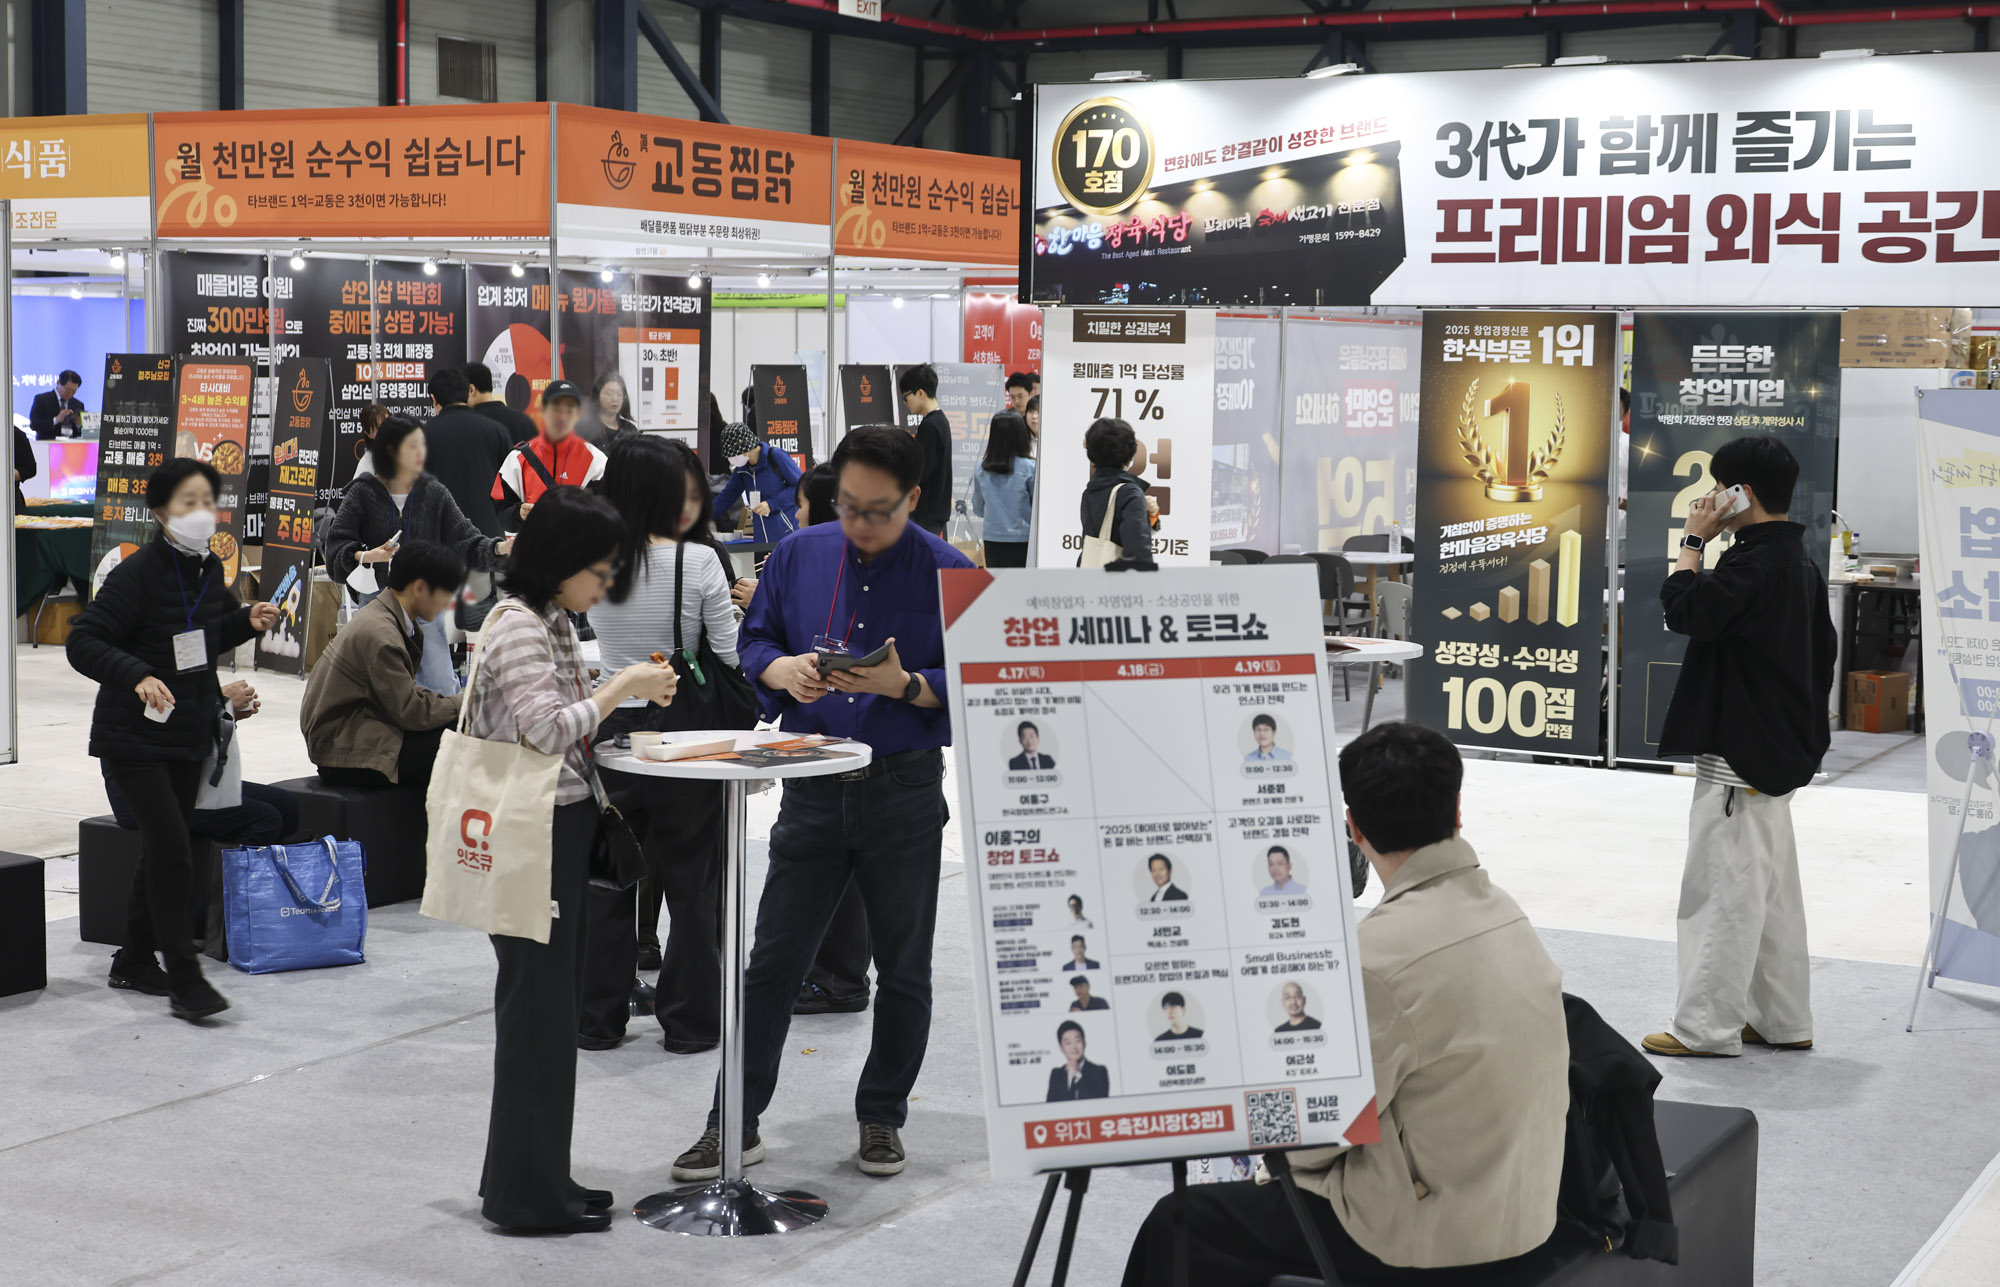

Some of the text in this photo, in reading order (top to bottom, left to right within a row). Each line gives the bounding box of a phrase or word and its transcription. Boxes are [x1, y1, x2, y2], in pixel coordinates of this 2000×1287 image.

[857, 0, 877, 16] EXIT
[1071, 127, 1141, 169] 170
[1163, 116, 1389, 172] 변화에도 한결같이 성장한 브랜드
[1599, 113, 1719, 176] 함께
[1732, 109, 1917, 174] 즐기는
[5, 138, 67, 179] 식품
[177, 135, 525, 180] 월 천만원 순수익 쉽습니다
[651, 136, 795, 205] 교동찜닭
[1083, 170, 1124, 194] 호점
[248, 192, 447, 208] 타브랜드 1억=교동은 3천이면 가능합니다!
[849, 169, 974, 214] 월 천만원 순수익
[1203, 198, 1381, 233] 프리미엄 전문점
[641, 219, 760, 241] 배달플랫폼 찜닭부분 주문량 최상위권!
[892, 221, 916, 235] 타브랜드
[1299, 228, 1382, 243] 가맹문의 1599-8429
[1431, 190, 2000, 265] 프리미엄 외식 공간
[1112, 251, 1124, 259] Best
[1125, 250, 1140, 260] Aged
[1157, 245, 1192, 256] Restaurant
[197, 273, 258, 298] 매몰비용
[397, 281, 442, 306] 박람회
[478, 286, 500, 307] 업계
[503, 286, 528, 307] 최저
[662, 295, 702, 314] 전격공개
[384, 310, 415, 334] 상담
[419, 311, 454, 336] 가능!
[1086, 320, 1171, 336] 치밀한 상권분석
[1445, 325, 1529, 337] 2025 창업경영신문
[973, 324, 995, 342] 고객이
[384, 343, 434, 360] 전체 매장중
[1443, 339, 1532, 363] 한식부문
[1538, 324, 1595, 367] 1위
[157, 359, 171, 369] 신규
[659, 348, 678, 362] 초반!
[1691, 344, 1775, 374] 든든한
[385, 362, 425, 379] 미만으로
[1073, 363, 1185, 380] 월매출 1억 달성률
[200, 382, 231, 393] 타사대비
[1679, 378, 1785, 407] 창업지원
[1657, 414, 1683, 425] 박람회
[1683, 414, 1716, 426] 기간동안
[1733, 415, 1750, 426] 상담
[1752, 415, 1760, 426] 후
[1761, 415, 1794, 427] 계약성사
[103, 451, 146, 466] 교동 매출
[193, 442, 213, 461] VS
[107, 477, 129, 494] 매출
[277, 514, 291, 540] 주
[292, 517, 313, 544] 6일
[1439, 512, 1533, 539] 거침없이 증명하는
[1439, 526, 1548, 560] 한마음정육식당
[1026, 593, 1240, 610] 예비창업자 자영업자 소상공인을 위한
[1003, 613, 1269, 647] 창업 세미나 & 토크쇼
[1435, 640, 1578, 674] 성장성 수익성
[997, 659, 1281, 680] 4.17(목) 4.18(금) 4.19(토)
[1545, 723, 1573, 740] 만점
[1134, 822, 1171, 833] 데이터로
[1228, 814, 1321, 828] 고객의 오감을 사로잡는
[985, 829, 1041, 846] 이홍구의
[1126, 833, 1212, 846] 버는 브랜드 선택하기
[1242, 826, 1309, 840] 브랜드 경험 전략
[457, 847, 493, 872] 잇츠큐
[987, 848, 1061, 866] 창업 토크쇼
[1245, 949, 1333, 964] Small Business는
[1241, 959, 1340, 976] 어떻게 성공해야 하는가?
[1306, 1095, 1339, 1108] 전시장
[1307, 1109, 1341, 1123] 배치도
[1054, 1110, 1225, 1143] 위치 우측전시장[3관]
